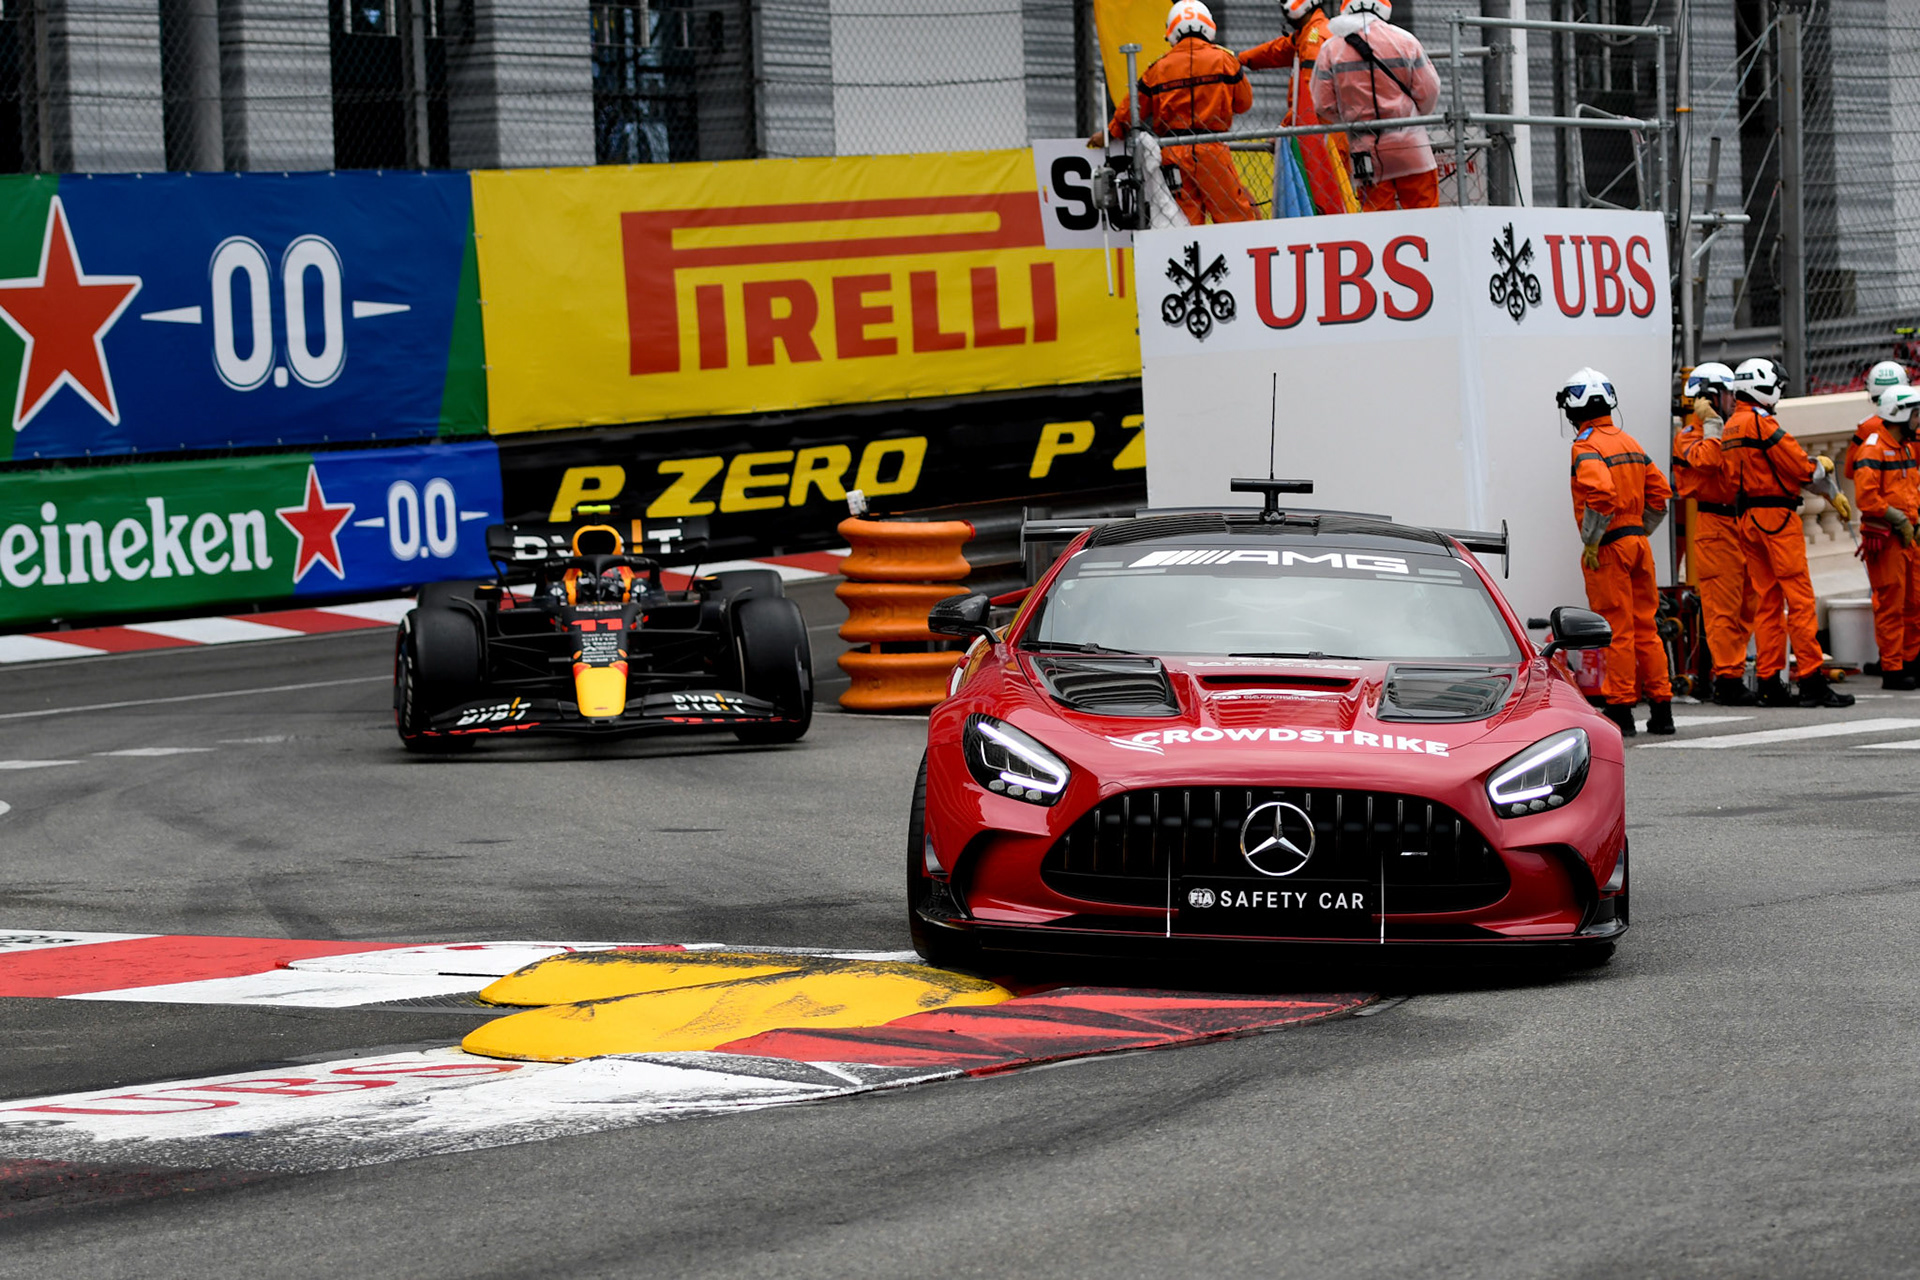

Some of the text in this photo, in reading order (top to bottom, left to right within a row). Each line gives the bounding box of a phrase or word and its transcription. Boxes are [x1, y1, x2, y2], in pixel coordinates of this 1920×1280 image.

[209, 233, 347, 392] 0.0
[620, 190, 1058, 376] PIRELLI
[1247, 235, 1434, 330] UBS
[1545, 233, 1657, 318] UBS
[547, 436, 928, 523] P ZERO
[1029, 420, 1096, 479] P
[0, 497, 273, 588] eineken
[387, 478, 458, 561] 0.0
[1215, 549, 1410, 574] AMG
[571, 618, 623, 632] 11
[1131, 726, 1451, 758] CROWDSTRIKE
[1220, 890, 1308, 909] SAFETY
[1318, 892, 1365, 910] CAR
